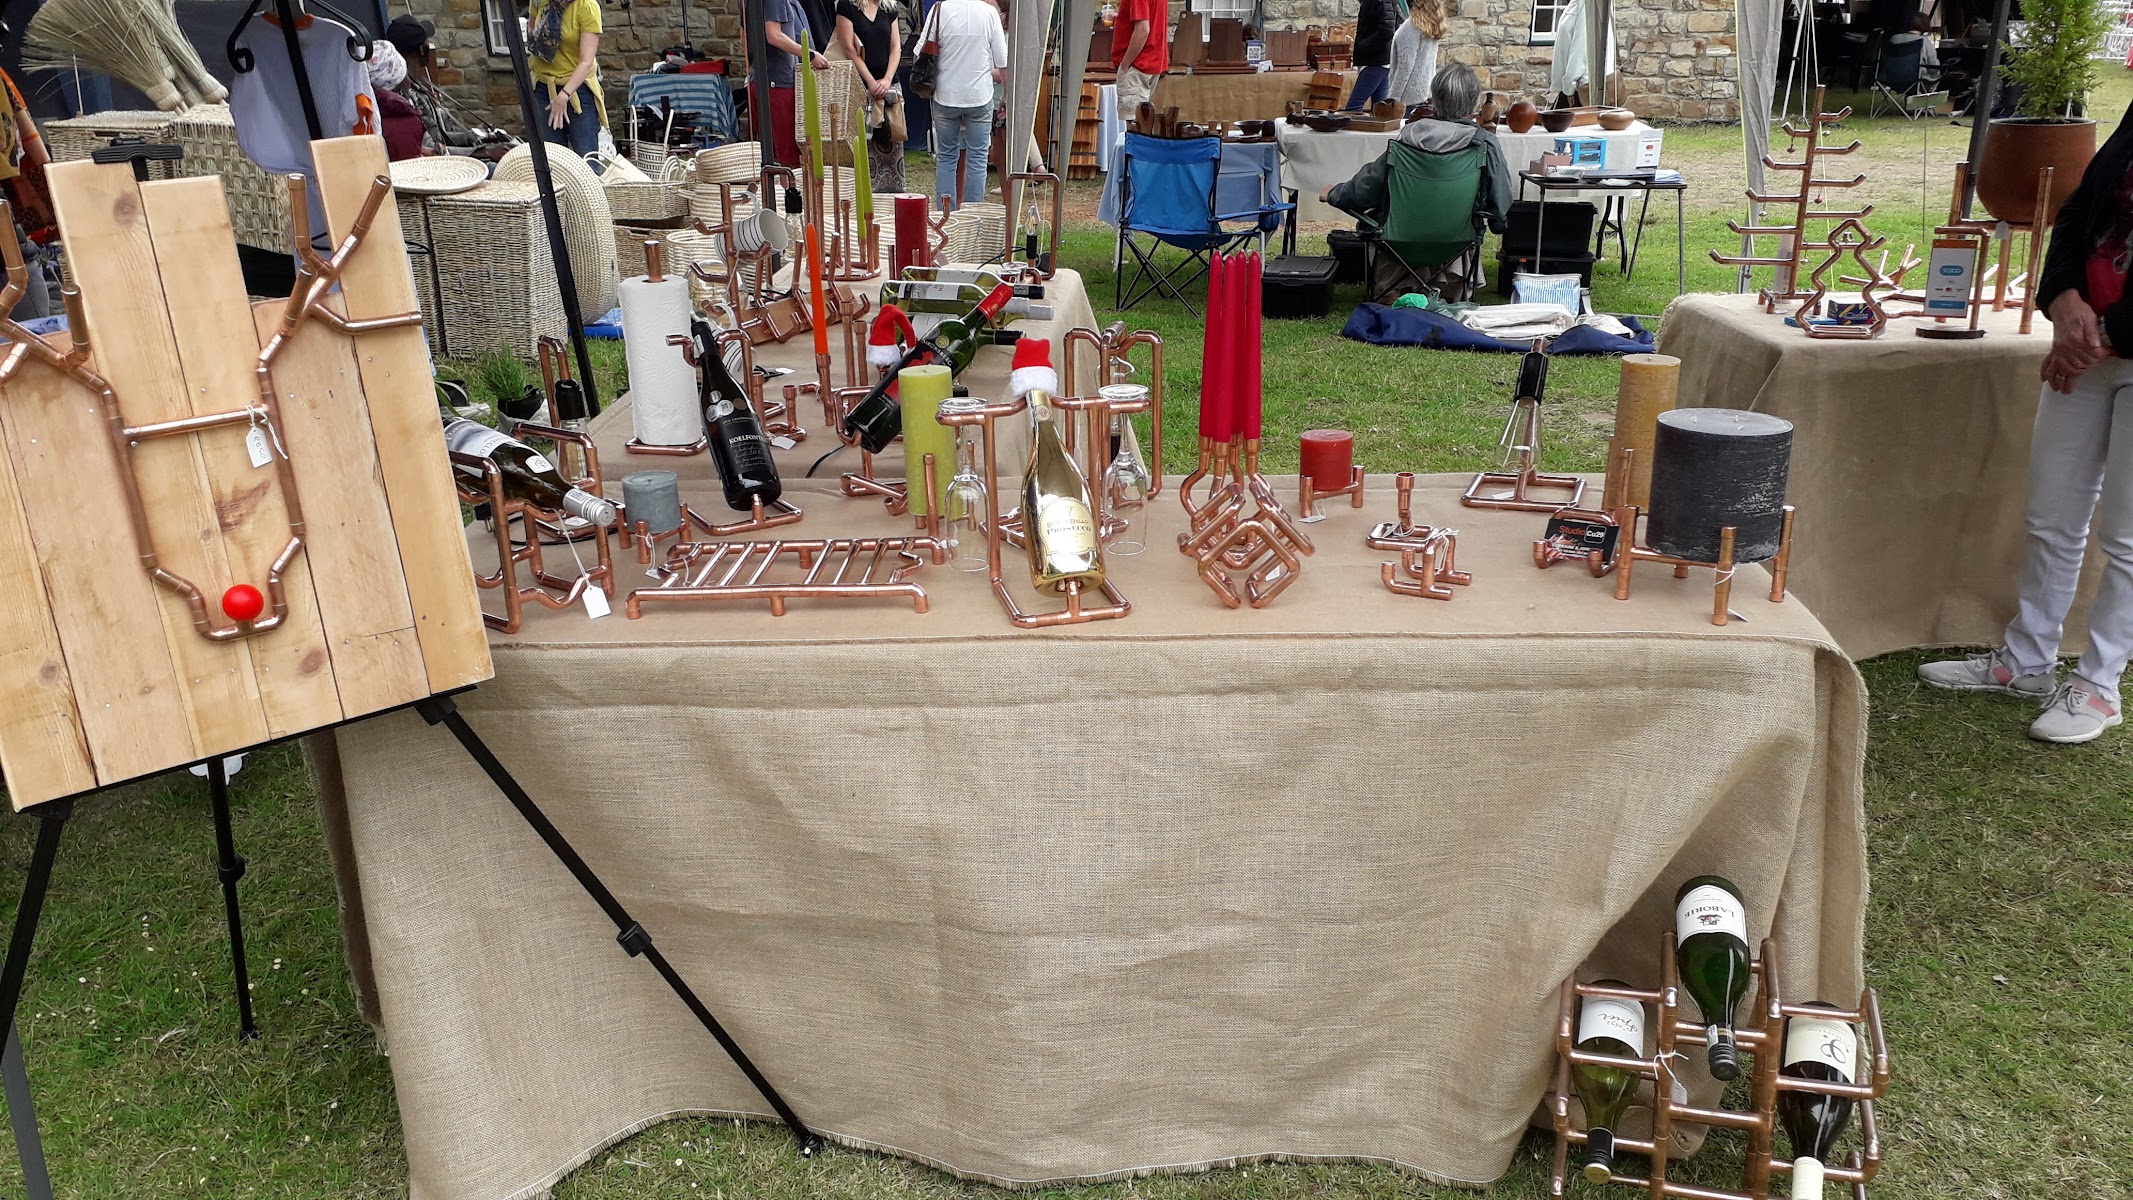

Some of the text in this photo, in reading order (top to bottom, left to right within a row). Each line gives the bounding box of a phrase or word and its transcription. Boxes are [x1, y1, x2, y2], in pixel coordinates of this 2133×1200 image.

[1558, 525, 1605, 539] Studio Cu29
[1684, 905, 1735, 919] LABORIE
